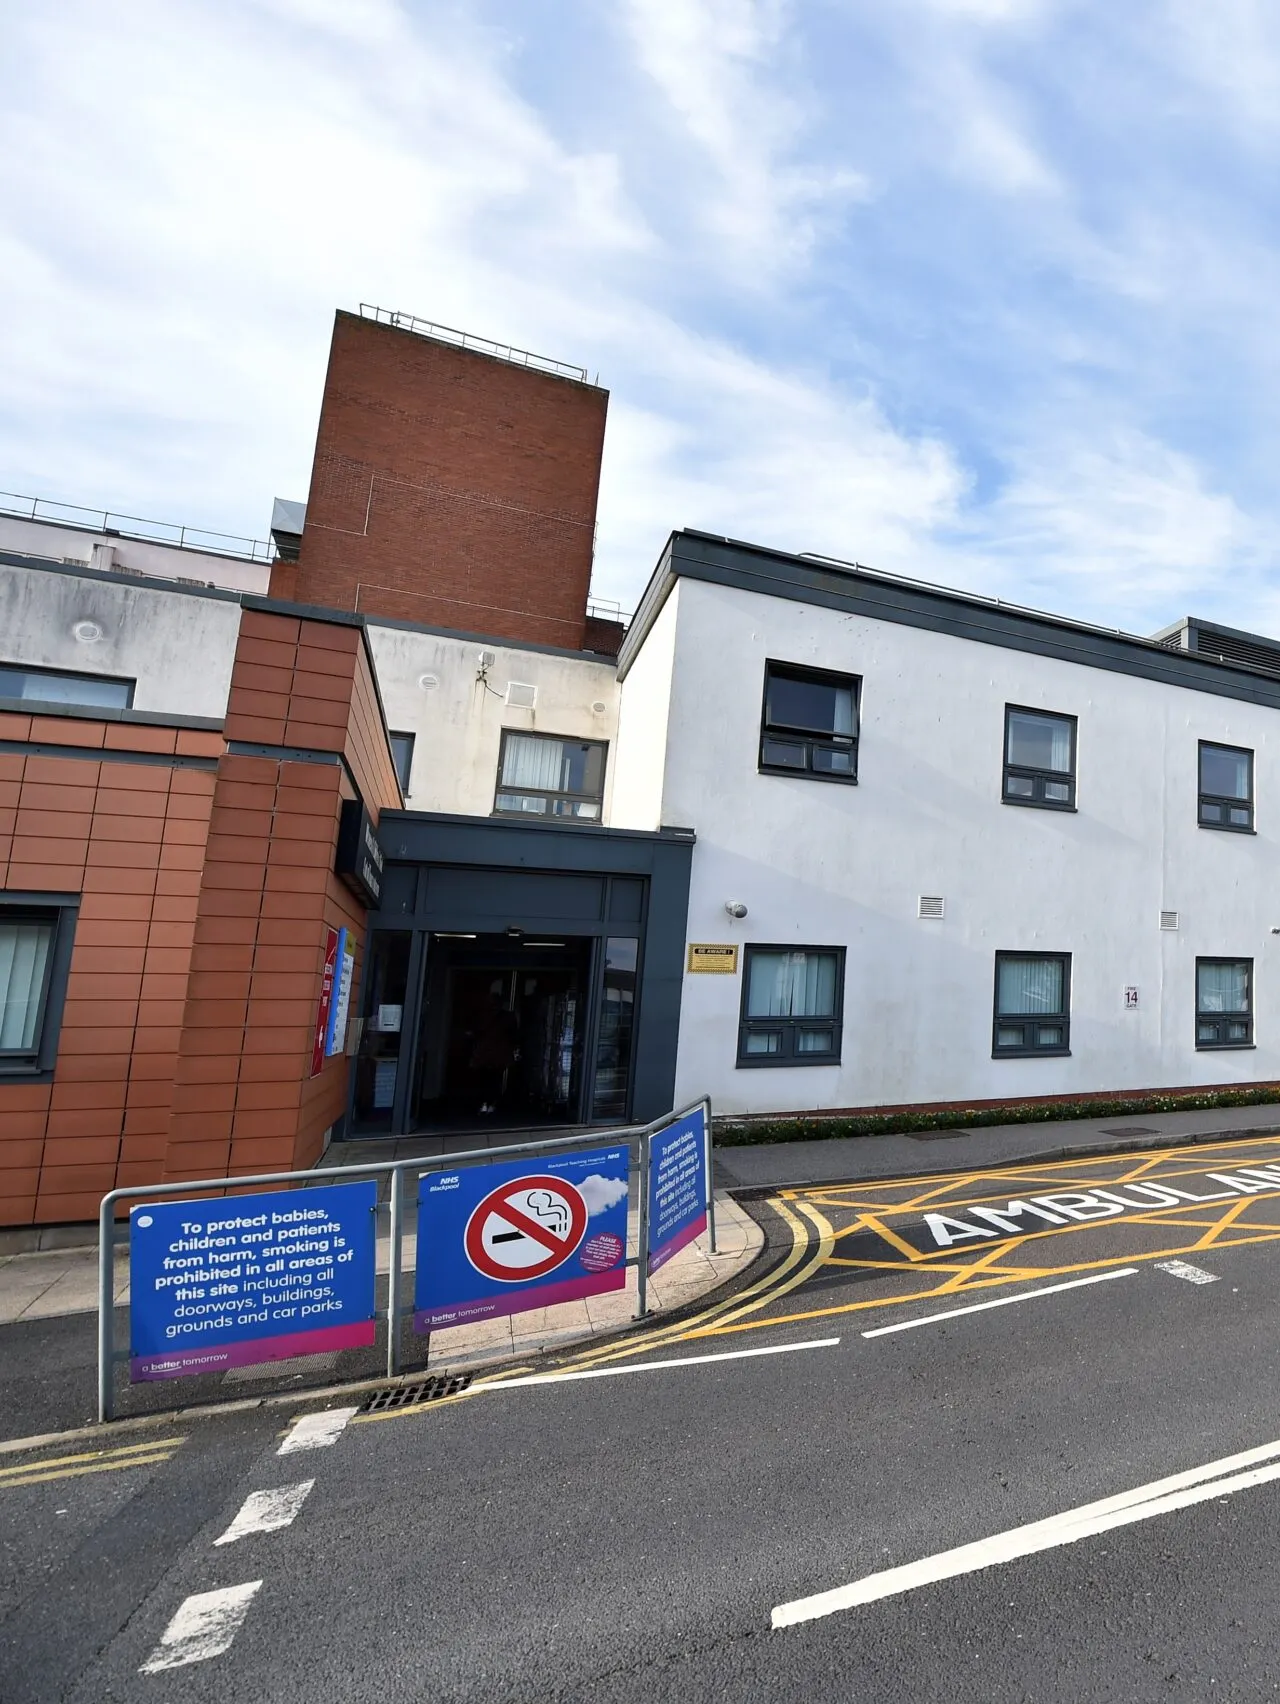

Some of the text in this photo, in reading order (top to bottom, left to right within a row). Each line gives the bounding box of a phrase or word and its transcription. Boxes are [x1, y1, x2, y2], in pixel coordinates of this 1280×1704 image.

[1125, 991, 1138, 1003] 14
[607, 1152, 620, 1160] NHS
[429, 1182, 460, 1192] Blackpool
[440, 1176, 460, 1185] NHS
[181, 1208, 329, 1235] To protect babies,
[169, 1221, 341, 1252] children and patients
[163, 1236, 346, 1270] from harm, smoking is
[155, 1249, 354, 1290] prohibited in all areas of
[175, 1267, 334, 1301] this site including all
[174, 1286, 335, 1318] doorways, buildings,
[430, 1312, 457, 1324] better
[458, 1304, 496, 1317] tomorrow
[165, 1299, 343, 1338] grounds and car parks
[150, 1360, 182, 1373] better
[182, 1353, 229, 1366] tomorrow
